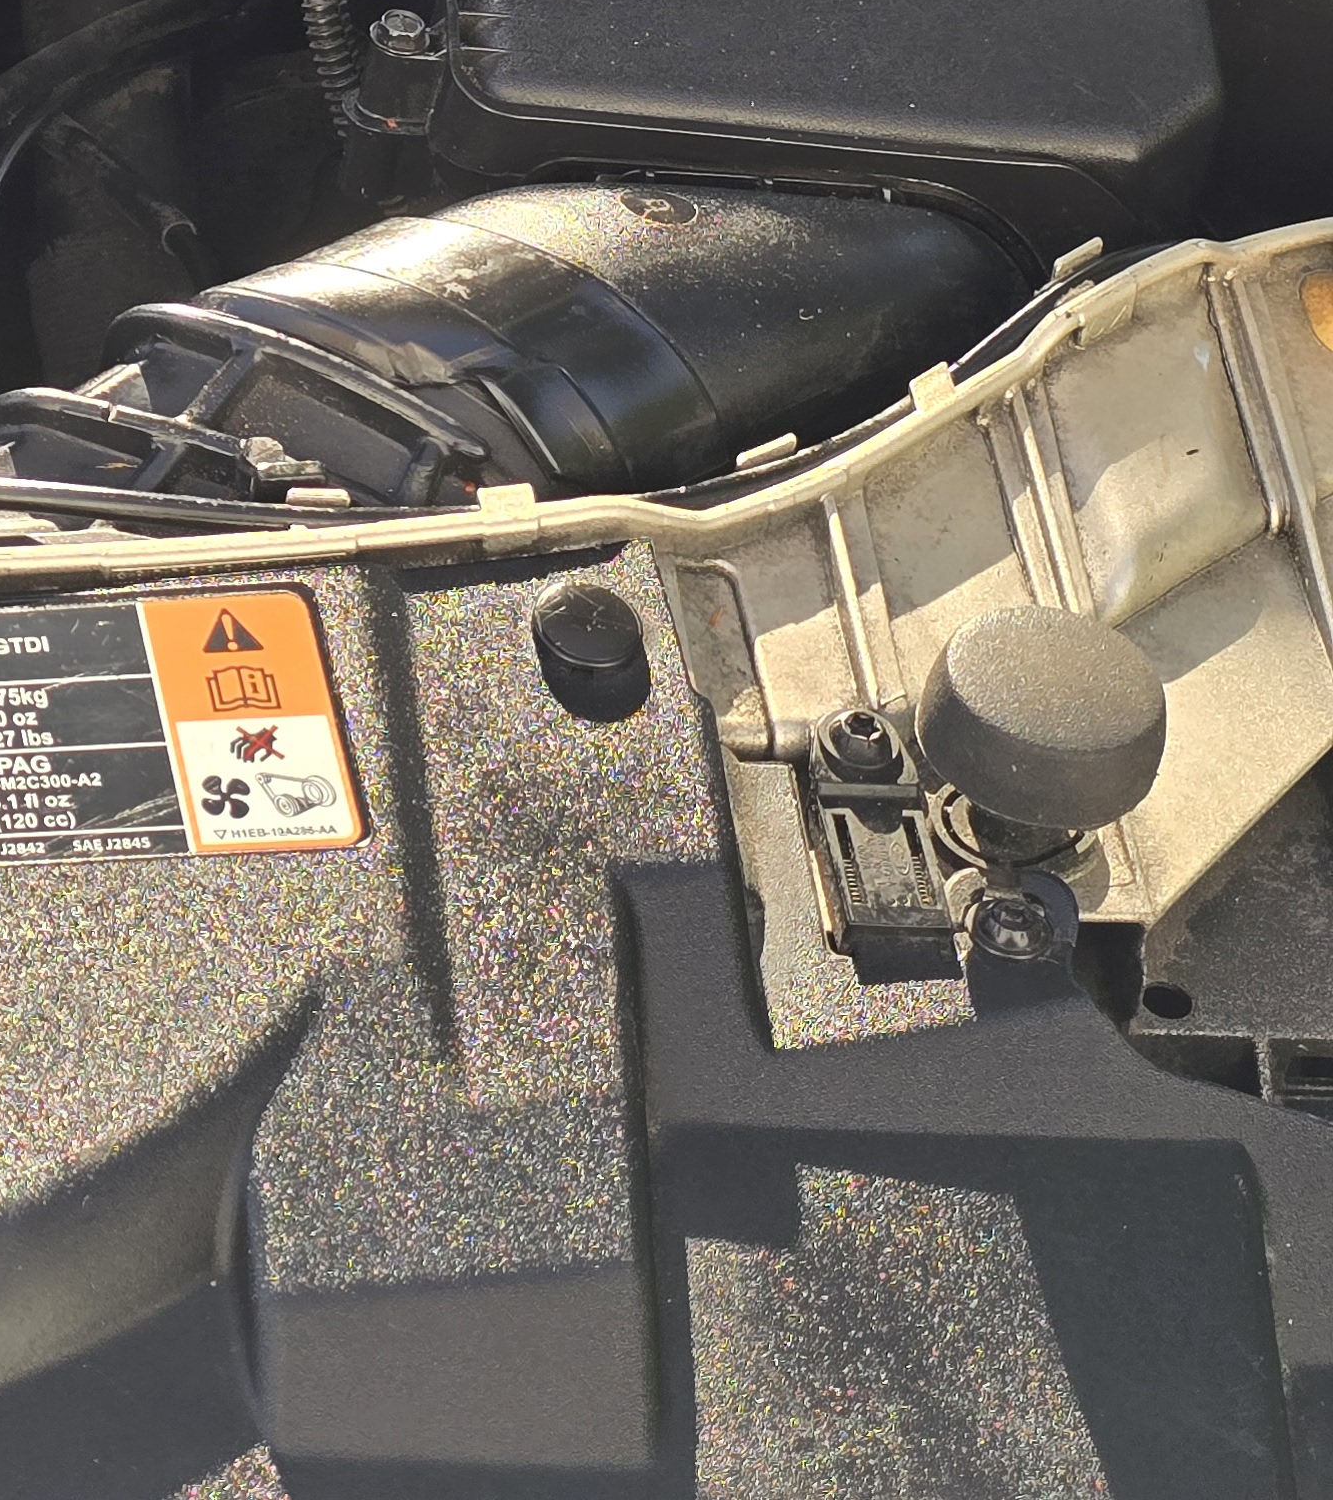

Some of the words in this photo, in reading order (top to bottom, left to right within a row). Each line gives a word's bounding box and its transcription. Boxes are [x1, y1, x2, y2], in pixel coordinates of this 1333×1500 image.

[13, 712, 38, 726] oz
[22, 729, 54, 747] lbs
[24, 793, 39, 809] fl
[45, 794, 73, 808] oz
[43, 811, 76, 829] cc)
[0, 842, 46, 856] J2842
[72, 839, 103, 853] SAE
[105, 837, 151, 851] J2845
